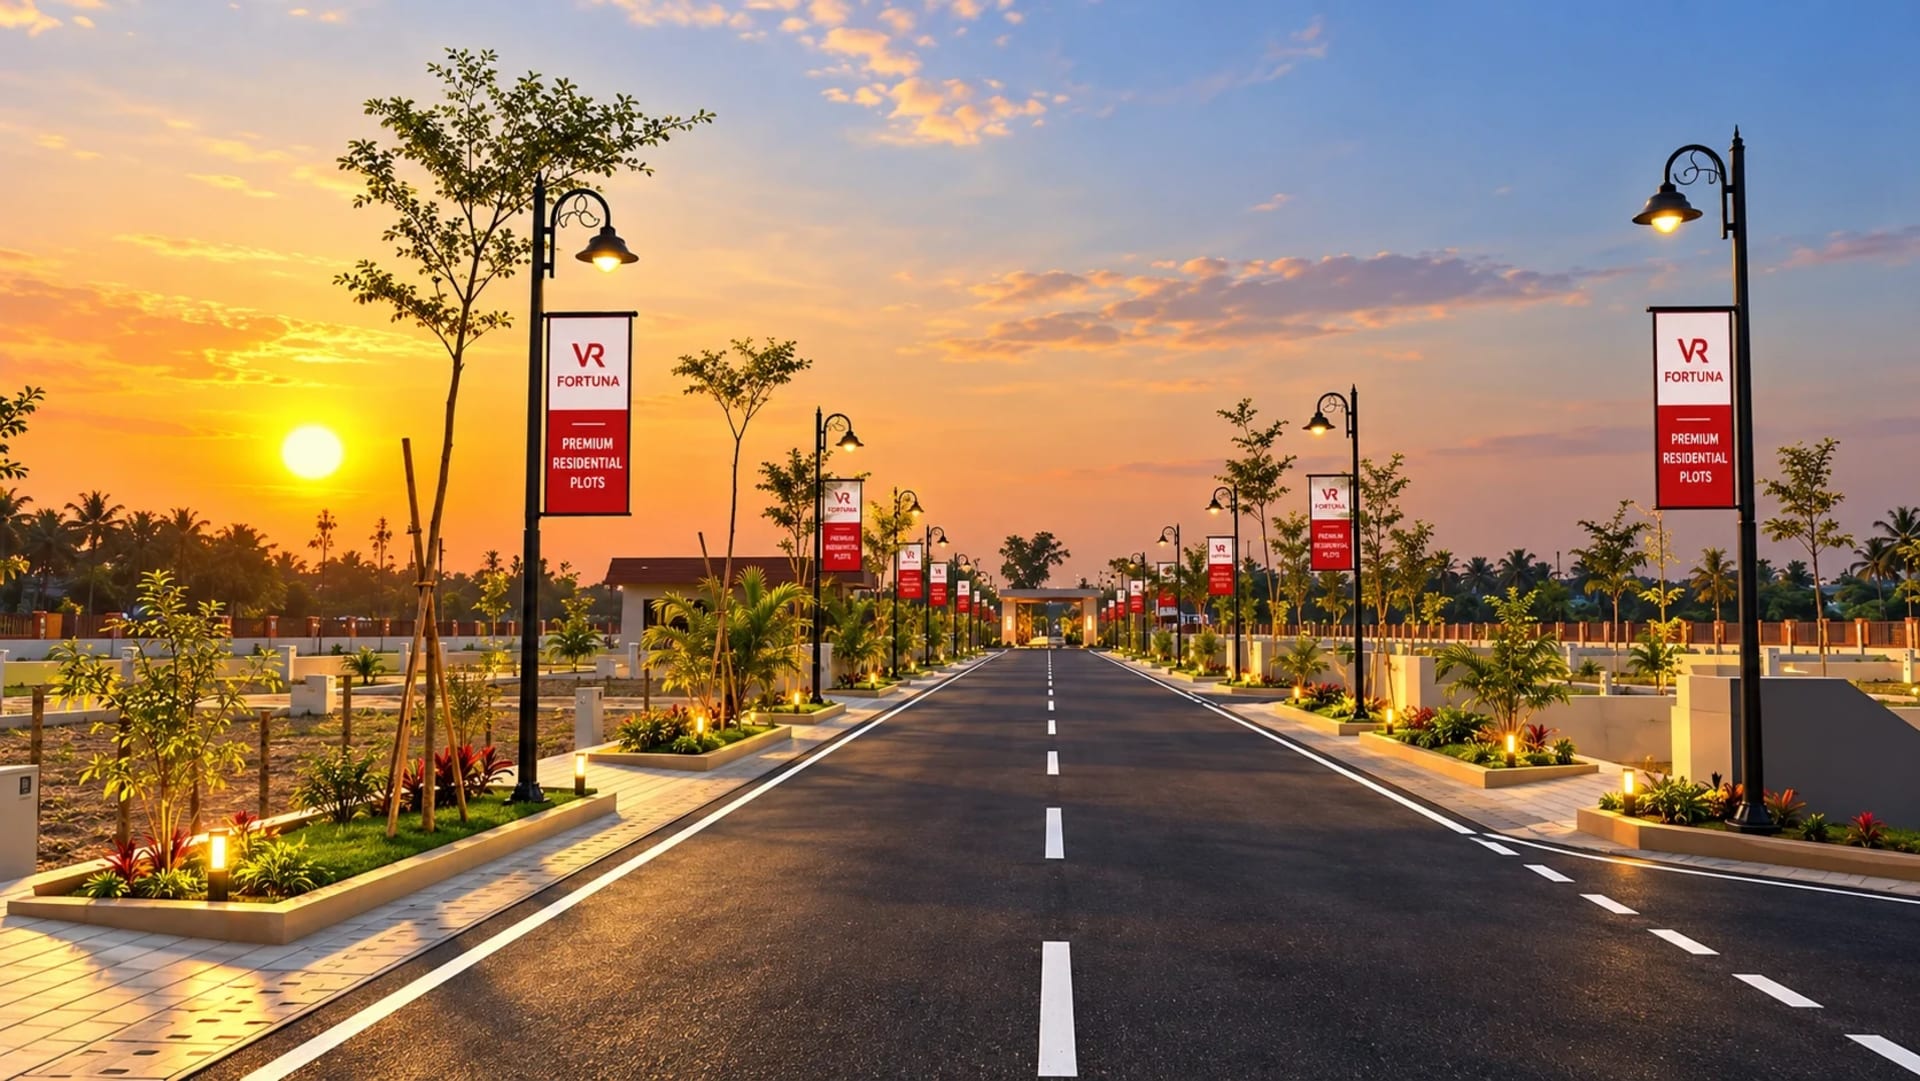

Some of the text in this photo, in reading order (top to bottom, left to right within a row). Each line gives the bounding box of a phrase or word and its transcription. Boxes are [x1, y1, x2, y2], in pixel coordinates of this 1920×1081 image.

[572, 343, 605, 368] VR
[1678, 338, 1709, 363] VR
[557, 376, 620, 387] FORTUNA
[1664, 371, 1723, 383] FORTUNA
[562, 437, 613, 450] PREMIUM
[1671, 433, 1718, 445] PREMIUM
[553, 457, 623, 469] RESIDENTIAL
[1663, 452, 1728, 464] RESIDENTIAL
[570, 476, 605, 489] PLOTS
[1680, 471, 1712, 483] PLOTS
[834, 491, 850, 504] VR
[1322, 488, 1338, 501] VR
